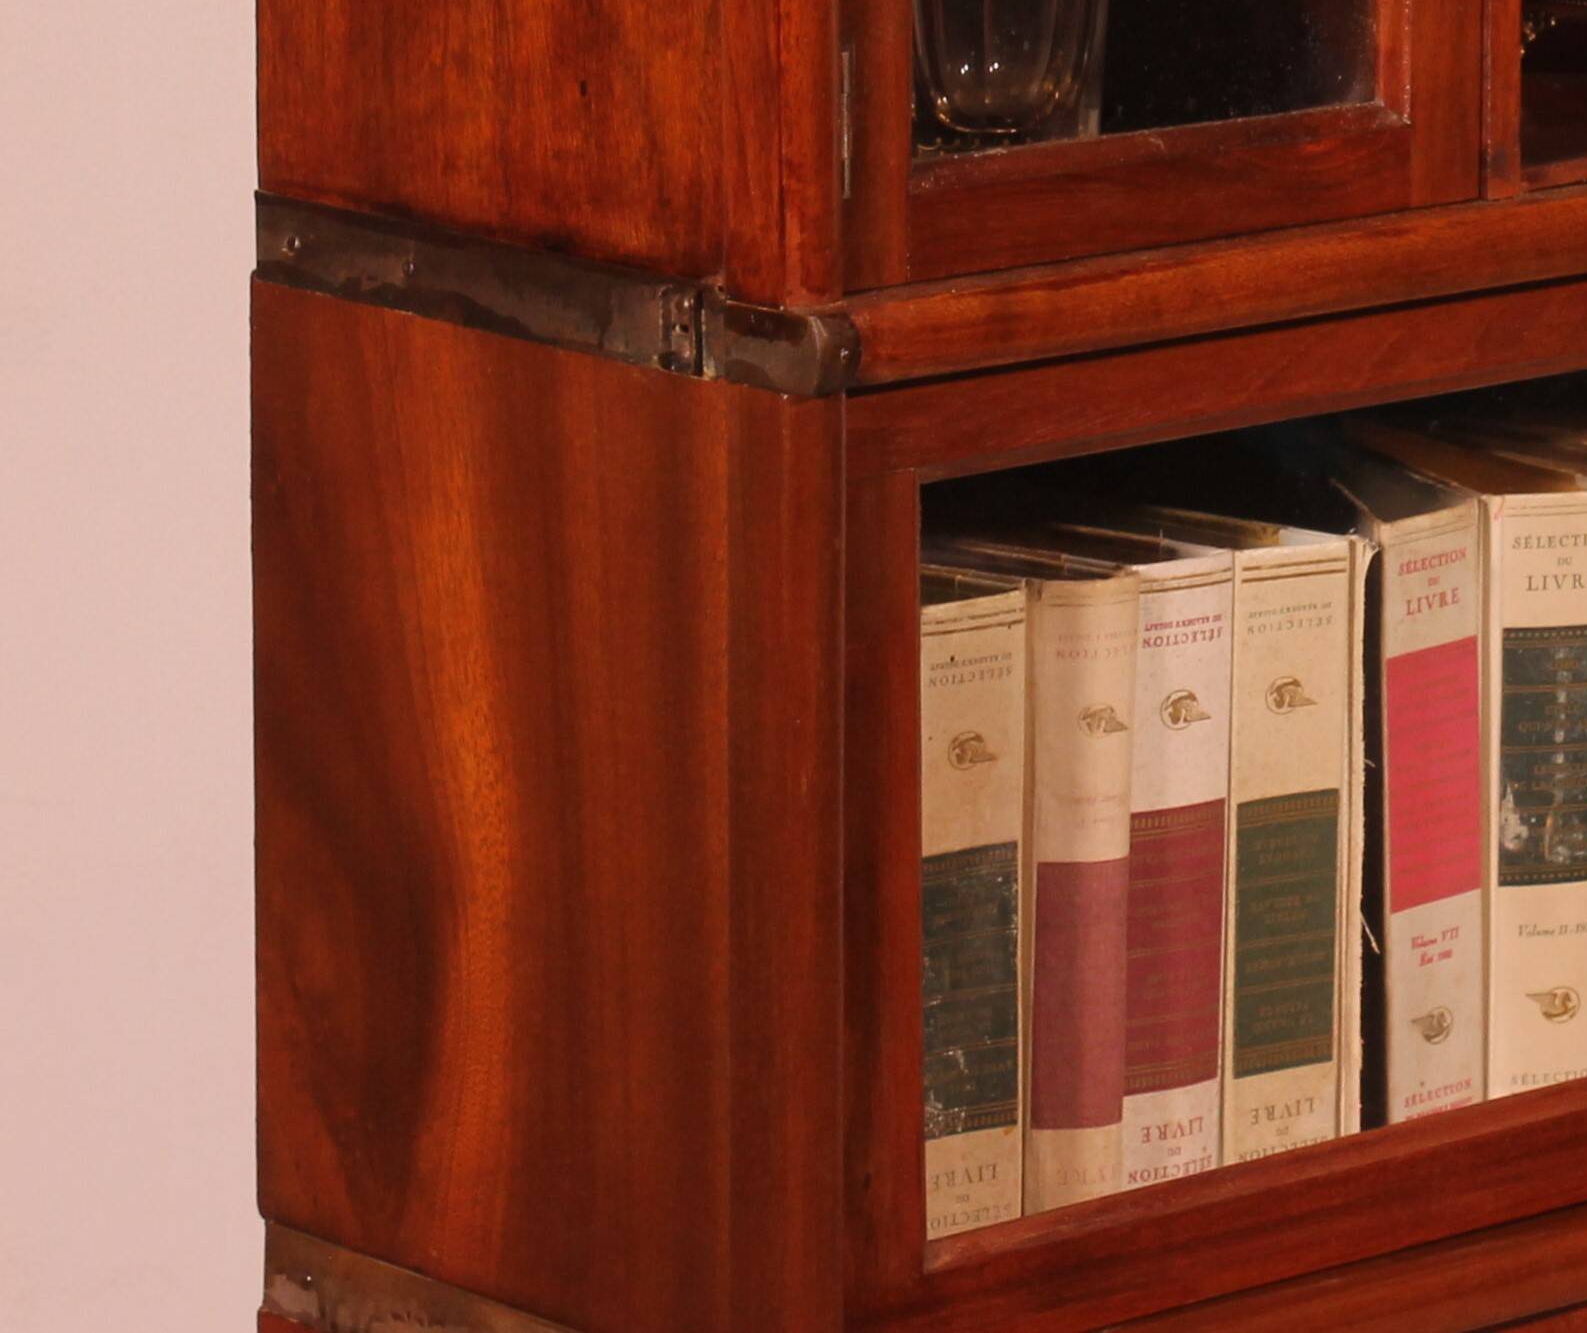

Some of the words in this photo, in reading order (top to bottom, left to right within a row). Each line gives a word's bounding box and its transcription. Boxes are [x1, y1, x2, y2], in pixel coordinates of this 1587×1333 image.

[1397, 547, 1467, 577] SÉLECTION
[1557, 556, 1573, 566] DU
[1406, 587, 1461, 616] LIVRE
[1142, 626, 1223, 649] SÉLECTION
[1517, 923, 1555, 938] Volume
[1250, 1096, 1316, 1126] LIVRE
[1139, 1115, 1205, 1144] LIVRE
[930, 1162, 1000, 1193] LIVRE
